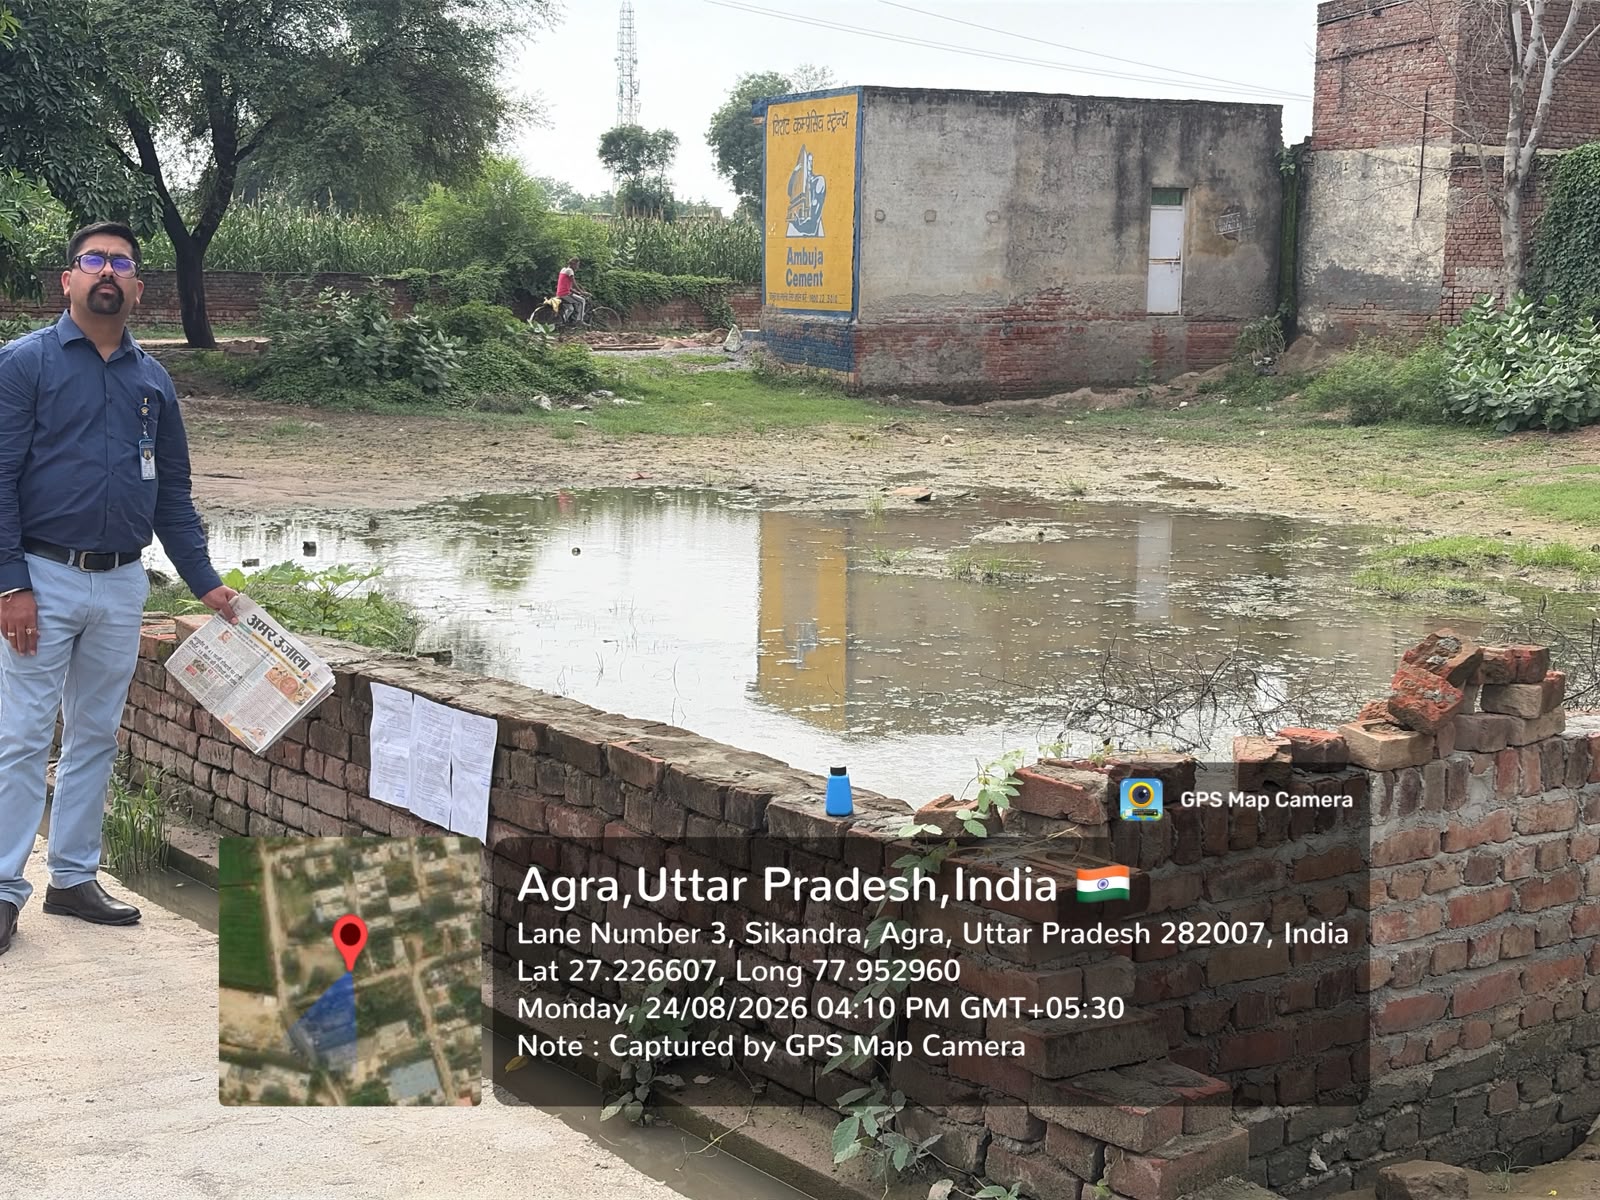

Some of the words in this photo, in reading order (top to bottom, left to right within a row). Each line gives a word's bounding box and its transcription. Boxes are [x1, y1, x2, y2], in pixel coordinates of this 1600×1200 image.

[772, 113, 791, 136] विराट
[786, 246, 824, 268] Ambuja
[785, 268, 824, 287] Cement
[246, 614, 279, 642] अमर
[274, 635, 312, 672] उजाला
